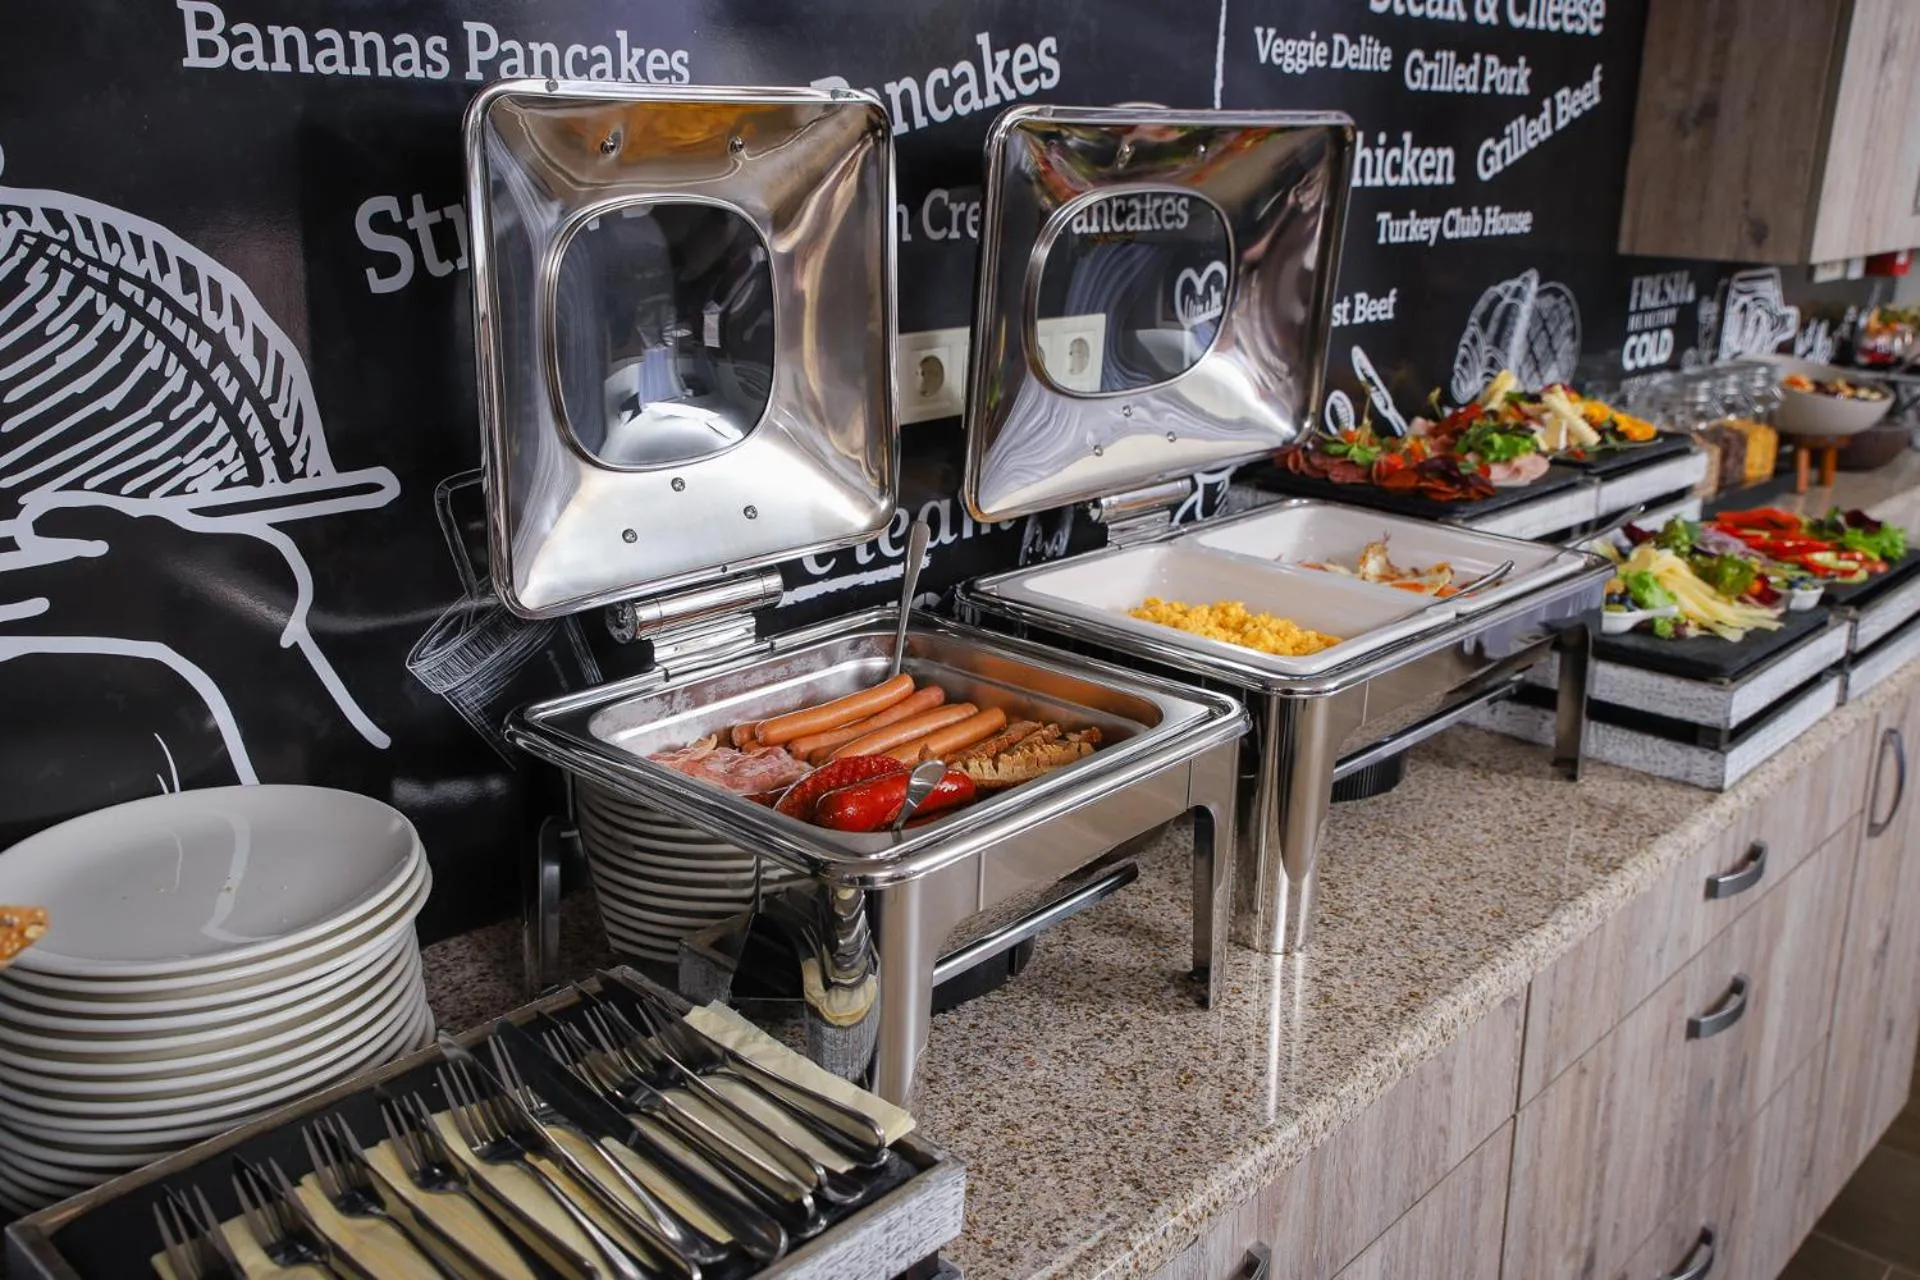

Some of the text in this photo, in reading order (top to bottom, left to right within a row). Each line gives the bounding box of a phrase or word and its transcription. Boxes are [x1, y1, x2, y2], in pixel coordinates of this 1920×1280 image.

[1505, 0, 1606, 36] Cheese
[177, 0, 691, 84] Bananas Pancakes
[1254, 26, 1393, 74] Veggie Delite
[810, 31, 1061, 137] ncakes
[1404, 50, 1532, 97] Grilled Pork
[1477, 63, 1604, 182] Grilled Beef
[1351, 130, 1456, 188] hicken
[1060, 193, 1190, 235] ancakes
[1376, 205, 1534, 248] Turkey Club House
[1352, 287, 1398, 325] Beef
[1622, 328, 1675, 371] COLD
